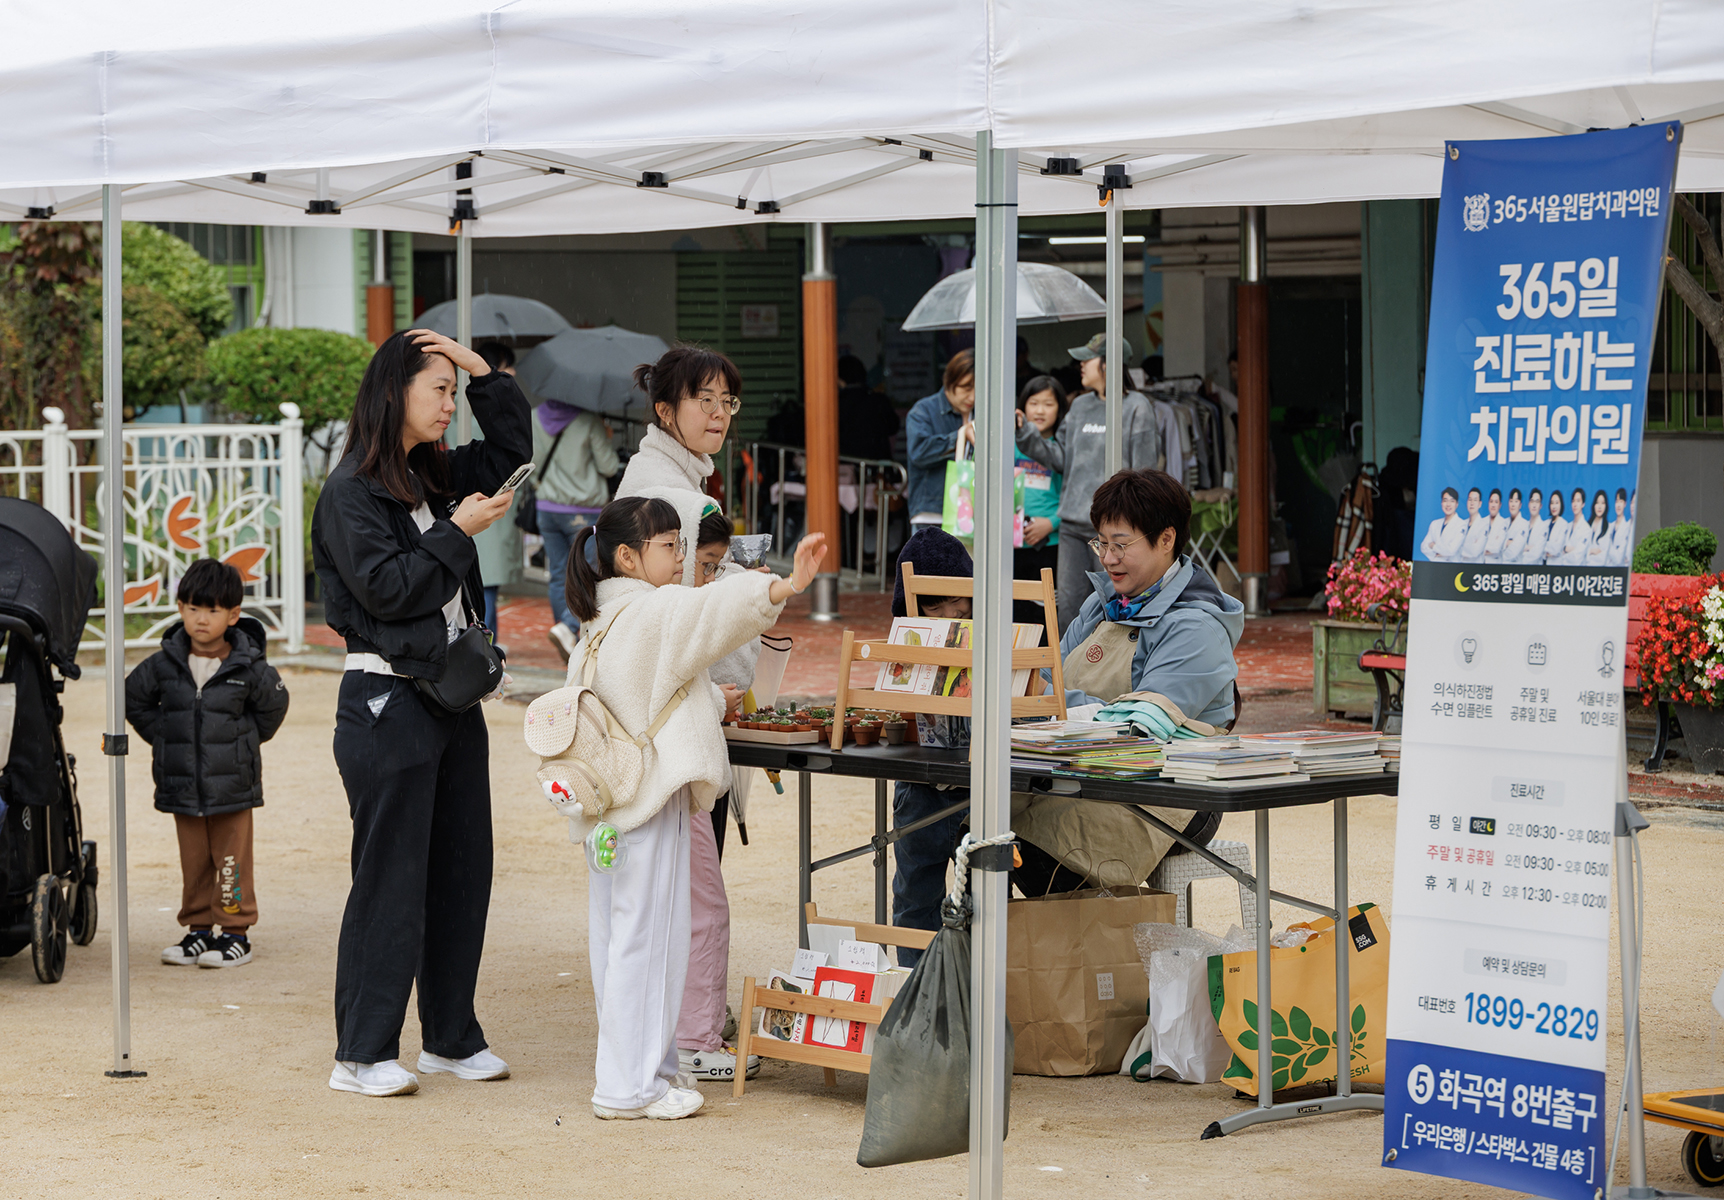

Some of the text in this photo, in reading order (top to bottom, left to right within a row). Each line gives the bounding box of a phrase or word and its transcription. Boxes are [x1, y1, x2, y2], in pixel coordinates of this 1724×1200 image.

[1493, 187, 1660, 224] 365서울원탑치과의원
[1496, 256, 1619, 321] 365일
[1474, 331, 1636, 393] 진료하는
[1467, 403, 1632, 465] 치과의원
[1472, 573, 1623, 597] 365 평일 매일 8시 야간진료
[1433, 682, 1493, 700] 의식하진정법
[1520, 687, 1549, 704] 주말 및
[1577, 690, 1605, 706] 서울대
[1431, 701, 1493, 719] 수면 임플란트
[1510, 706, 1557, 723] 공휴일 진료
[1580, 711, 1600, 726] 10인
[1510, 783, 1545, 800] 진료시간
[1472, 820, 1487, 832] 야간
[1507, 823, 1523, 838] 오전
[1526, 824, 1556, 839] 09:30
[1567, 829, 1584, 843] 오후
[1427, 845, 1494, 866] 주말 및 공휴일
[1505, 854, 1521, 869] 오전
[1523, 856, 1554, 871] 09:30
[1564, 860, 1581, 875] 오후
[221, 855, 235, 906] MONKEY
[1502, 886, 1519, 900] 오후
[1522, 887, 1552, 902] 12:30
[1562, 892, 1579, 906] 오후
[1355, 934, 1367, 943] SSG
[1482, 956, 1547, 979] 예약 및 상담문의
[1418, 991, 1599, 1042] 대표번호 1899-2829
[709, 1067, 748, 1076] cro
[1437, 1068, 1507, 1118] 화곡역
[1511, 1084, 1598, 1134] 8번출구
[1531, 1142, 1559, 1171] 건물
